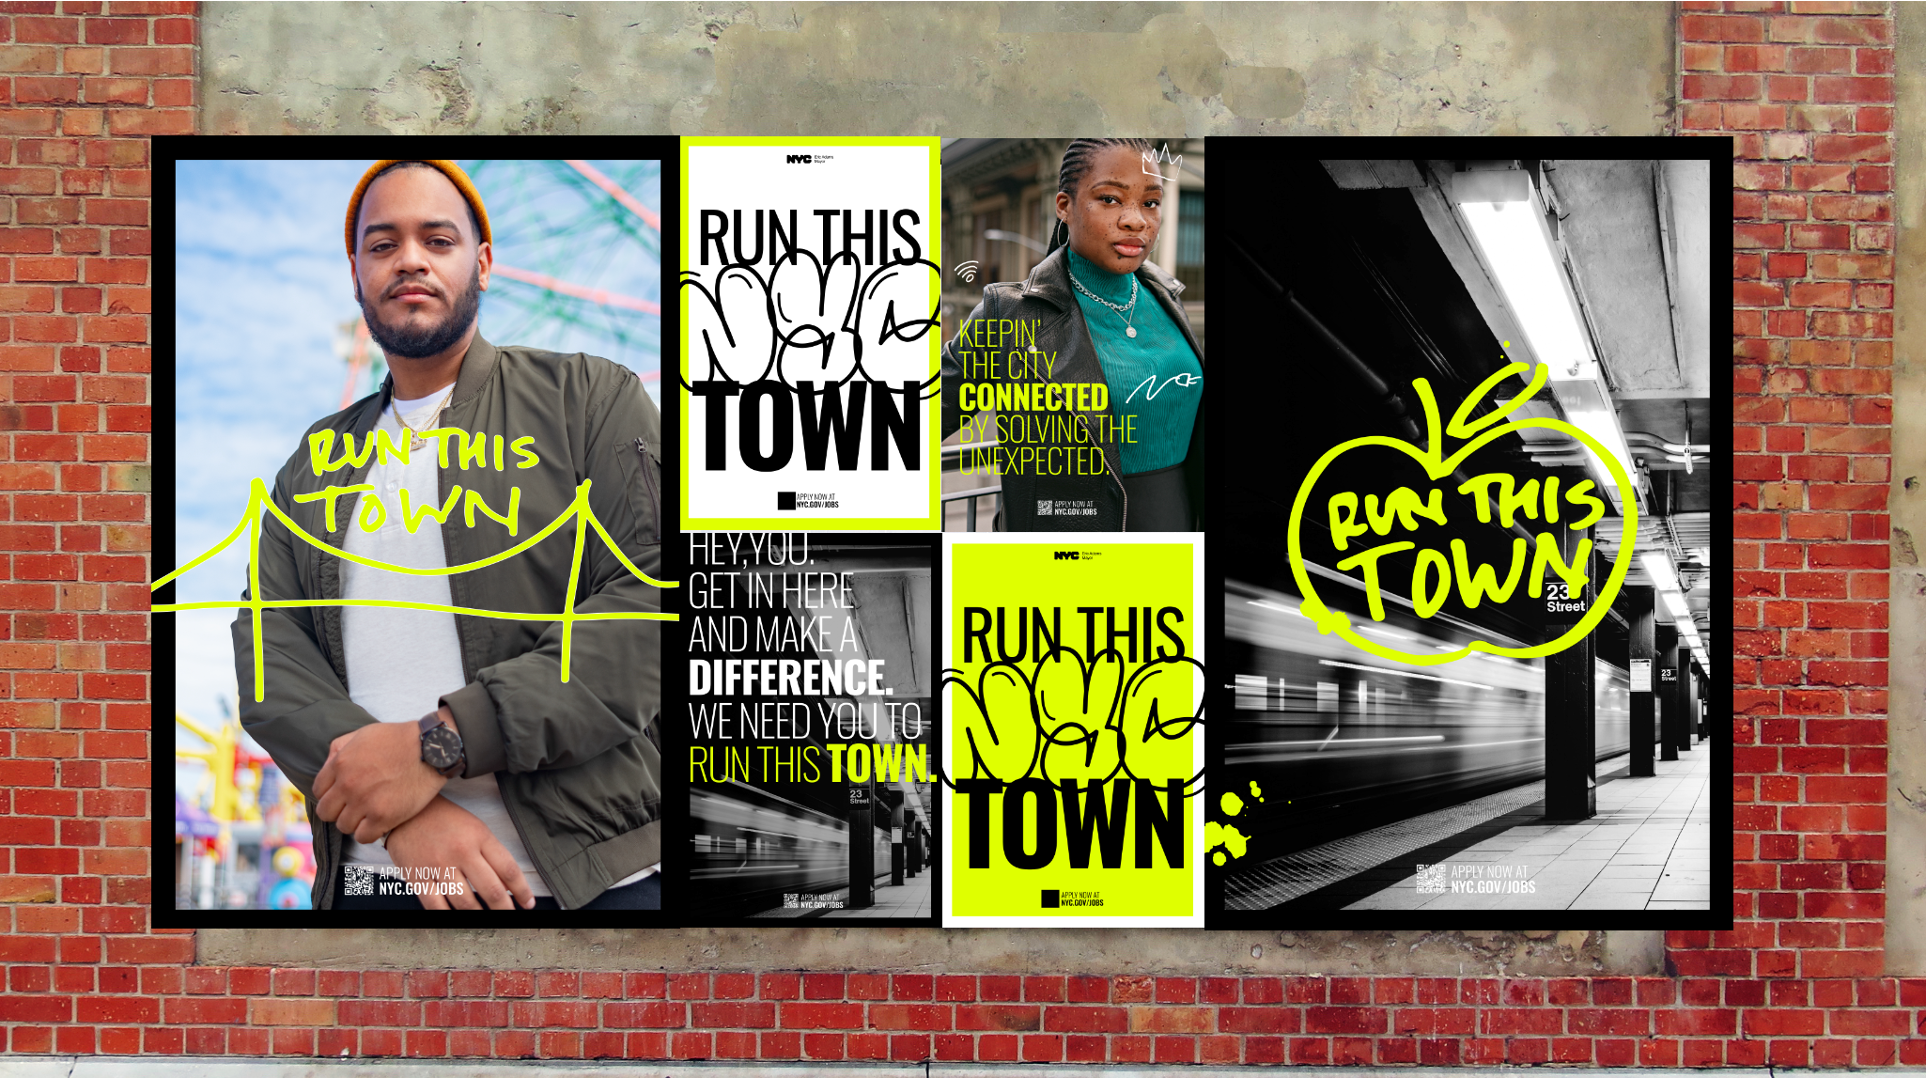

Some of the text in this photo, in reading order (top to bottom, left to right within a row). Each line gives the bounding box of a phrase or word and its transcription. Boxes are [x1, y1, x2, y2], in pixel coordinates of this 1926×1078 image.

[786, 155, 812, 164] NYC
[700, 208, 922, 266] RUN THIS
[958, 351, 1057, 380] THE CITY
[959, 383, 1109, 412] CONNECTED
[692, 380, 921, 473] TOWN
[959, 415, 1138, 444] BY SOLVING THE
[308, 426, 540, 476] RUN THIS
[959, 447, 1110, 476] UNEXPECTED.
[293, 484, 521, 537] TOWN
[1055, 500, 1071, 508] APPLY
[1328, 472, 1606, 551] RUN THIS
[1054, 551, 1079, 560] NYC
[689, 572, 854, 609] GET IN HERE
[1336, 532, 1593, 622] TOWN
[1546, 601, 1586, 612] Street
[689, 616, 858, 652] AND MAKE A
[964, 606, 1185, 663] RUN THIS
[689, 659, 893, 696] DIFFERENCE.
[1661, 669, 1672, 677] 23
[689, 703, 921, 739] WE NEED YOU TO
[690, 743, 937, 783] RUN THIS TOWN.
[850, 789, 863, 798] 23
[956, 778, 1185, 870] TOWN
[379, 866, 457, 880] APPLY NOW AT
[1451, 865, 1528, 878] APPLY NOW AT
[379, 882, 464, 895] NYC.GOV/JOBS
[1451, 880, 1536, 893] NYC.GOV/JOBS
